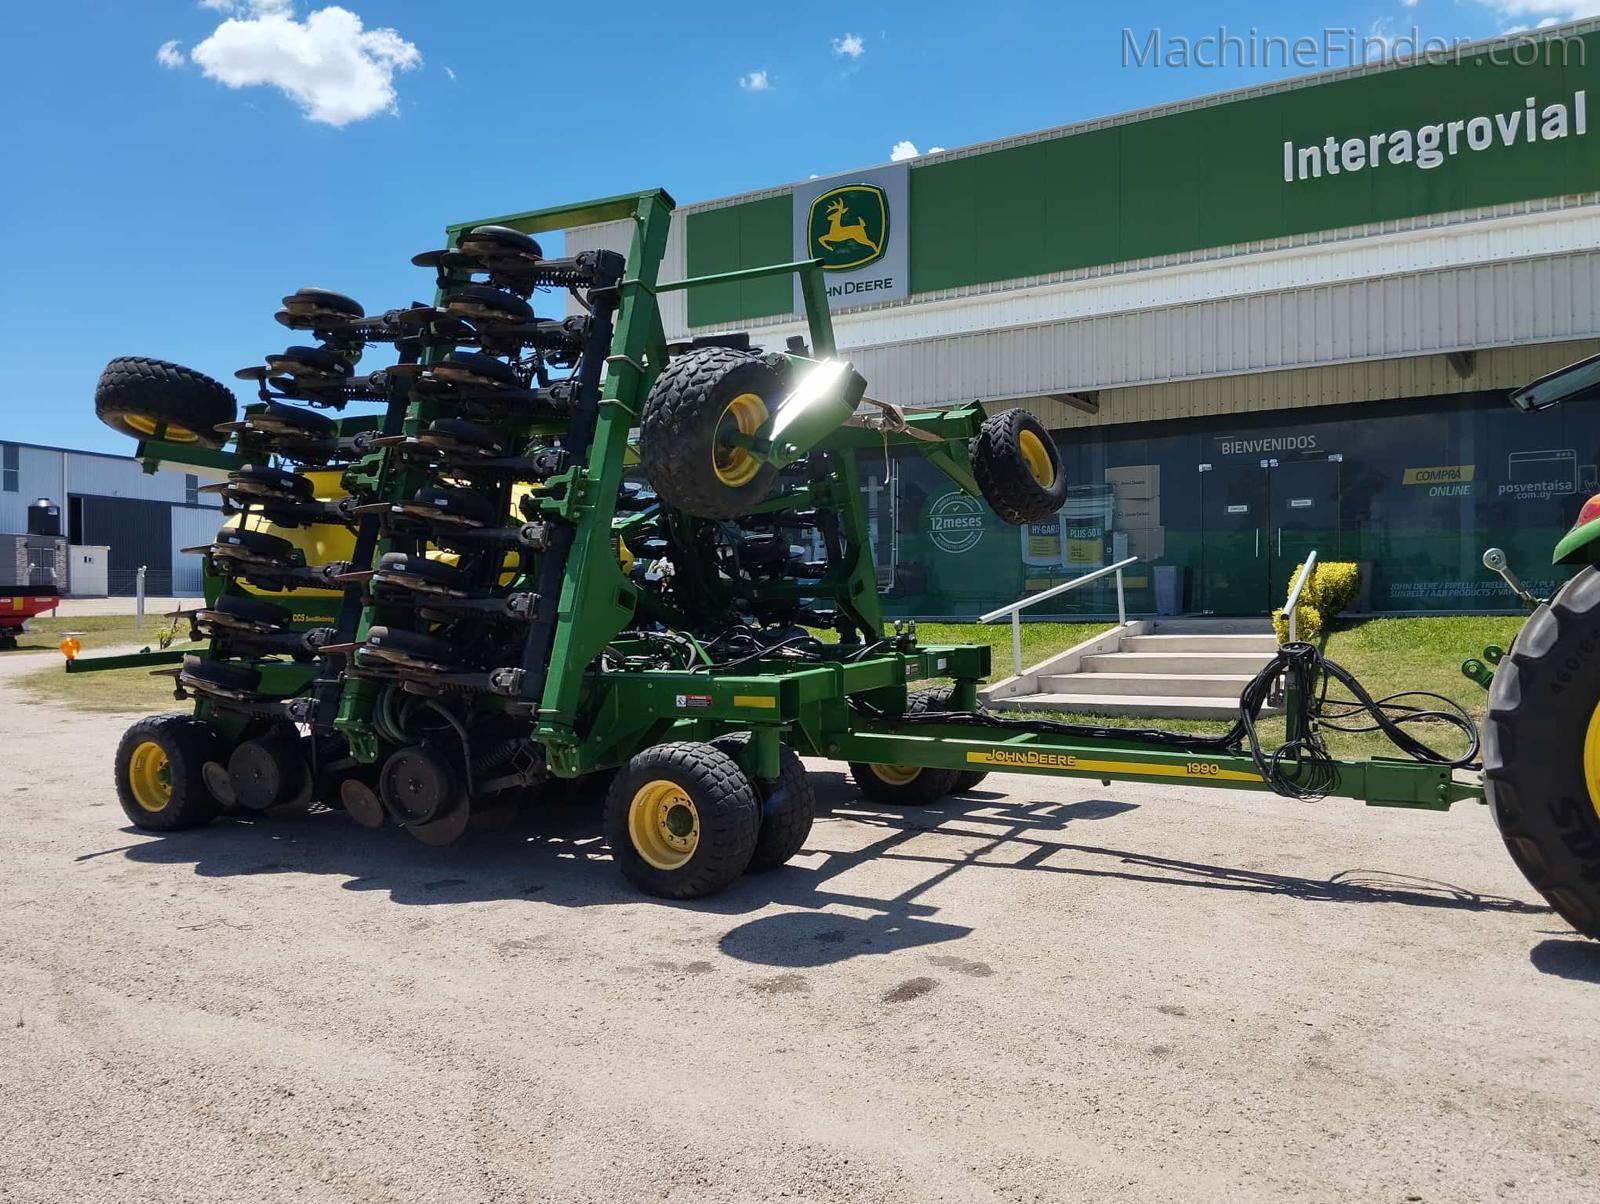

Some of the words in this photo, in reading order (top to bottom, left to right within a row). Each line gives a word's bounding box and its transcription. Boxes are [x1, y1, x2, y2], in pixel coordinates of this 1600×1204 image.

[1283, 90, 1587, 182] Interagrovial
[844, 278, 893, 295] DEERE
[1221, 435, 1316, 455] BIENVENIDOS
[1429, 485, 1472, 497] ONLINE
[986, 748, 1026, 763] JOHN
[1027, 751, 1076, 767] DEERE
[1186, 762, 1220, 775] 1990
